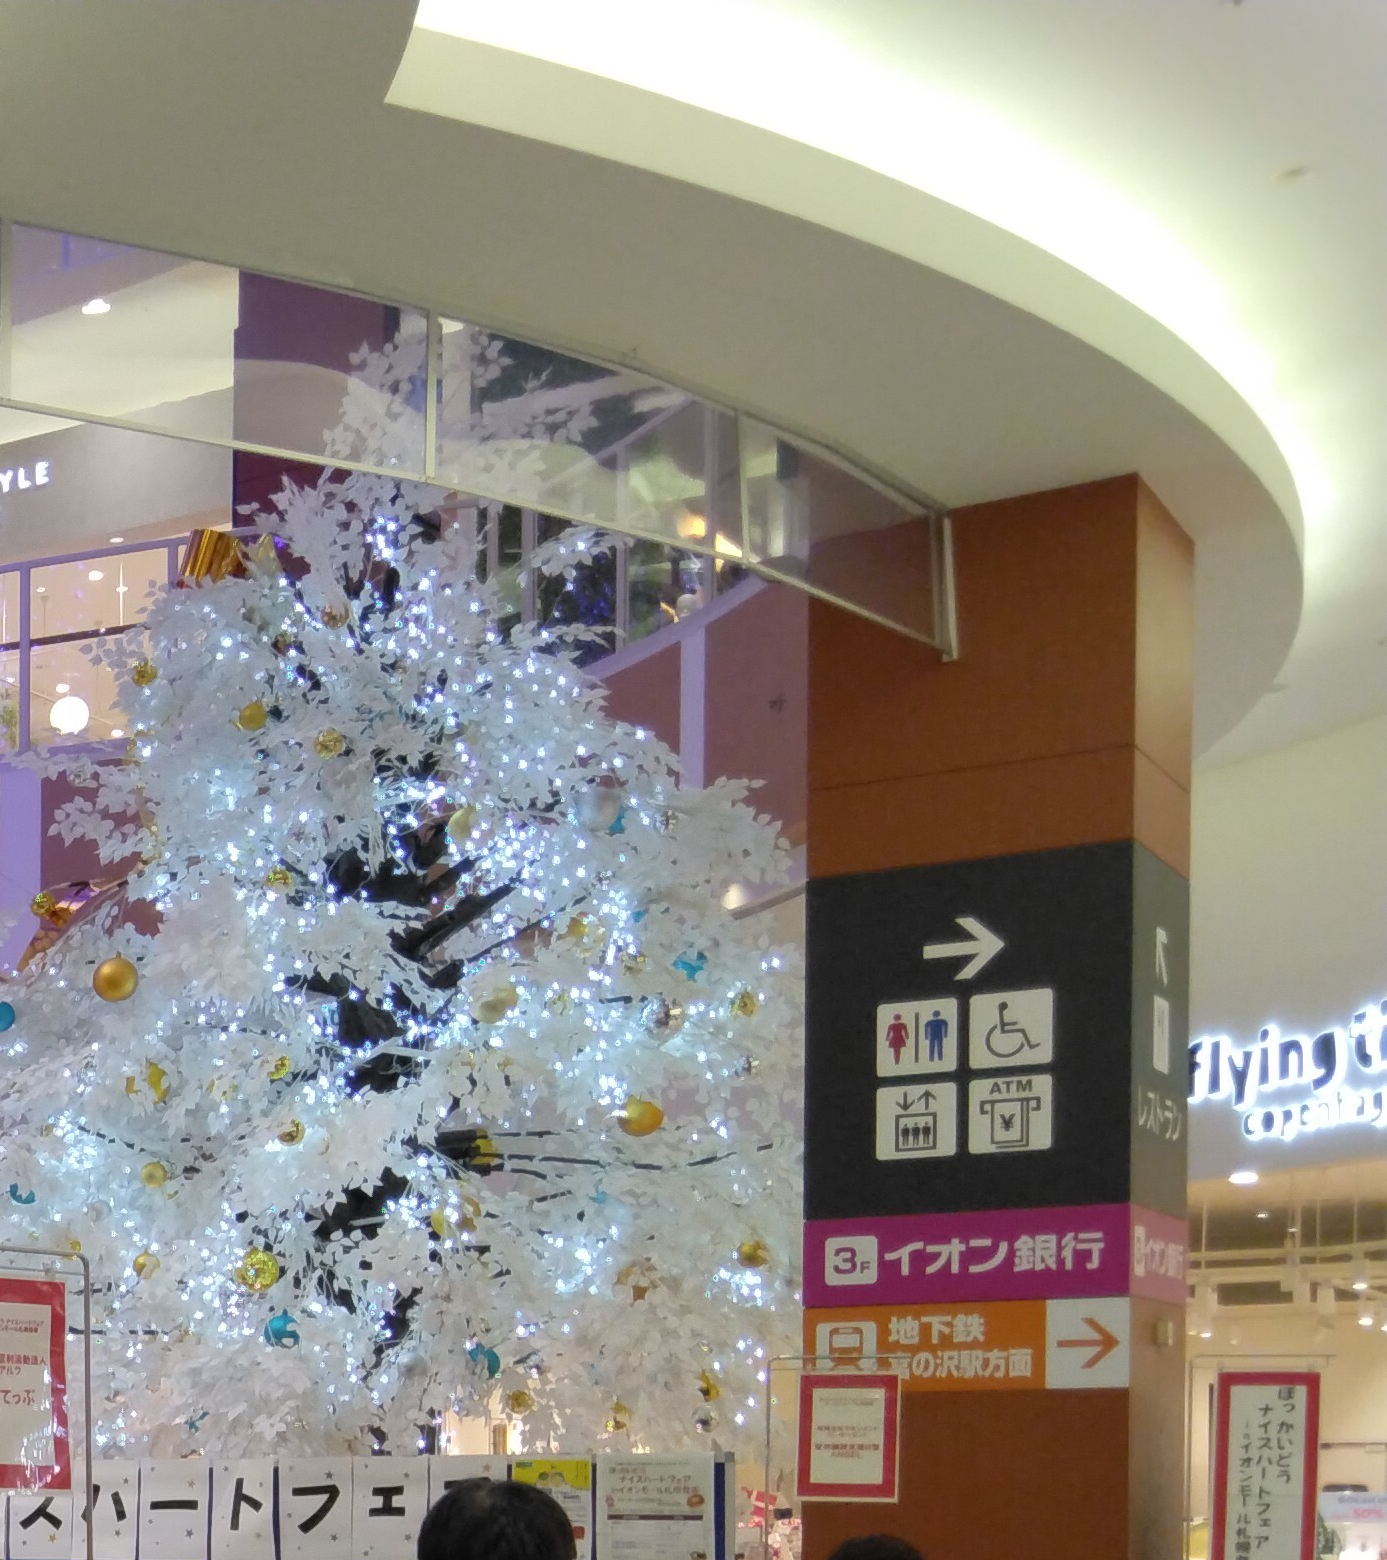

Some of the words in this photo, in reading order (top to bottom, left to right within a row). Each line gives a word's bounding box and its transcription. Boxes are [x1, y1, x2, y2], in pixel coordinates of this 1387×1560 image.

[989, 1079, 1033, 1095] ATM
[1138, 1085, 1182, 1142] レストラン
[832, 1246, 871, 1276] 3F
[884, 1231, 1105, 1276] イオン銀行
[888, 1314, 986, 1344] 地下鉄
[1277, 1386, 1296, 1485] ほっかいどう
[1255, 1403, 1274, 1550] ナイスハートフェア
